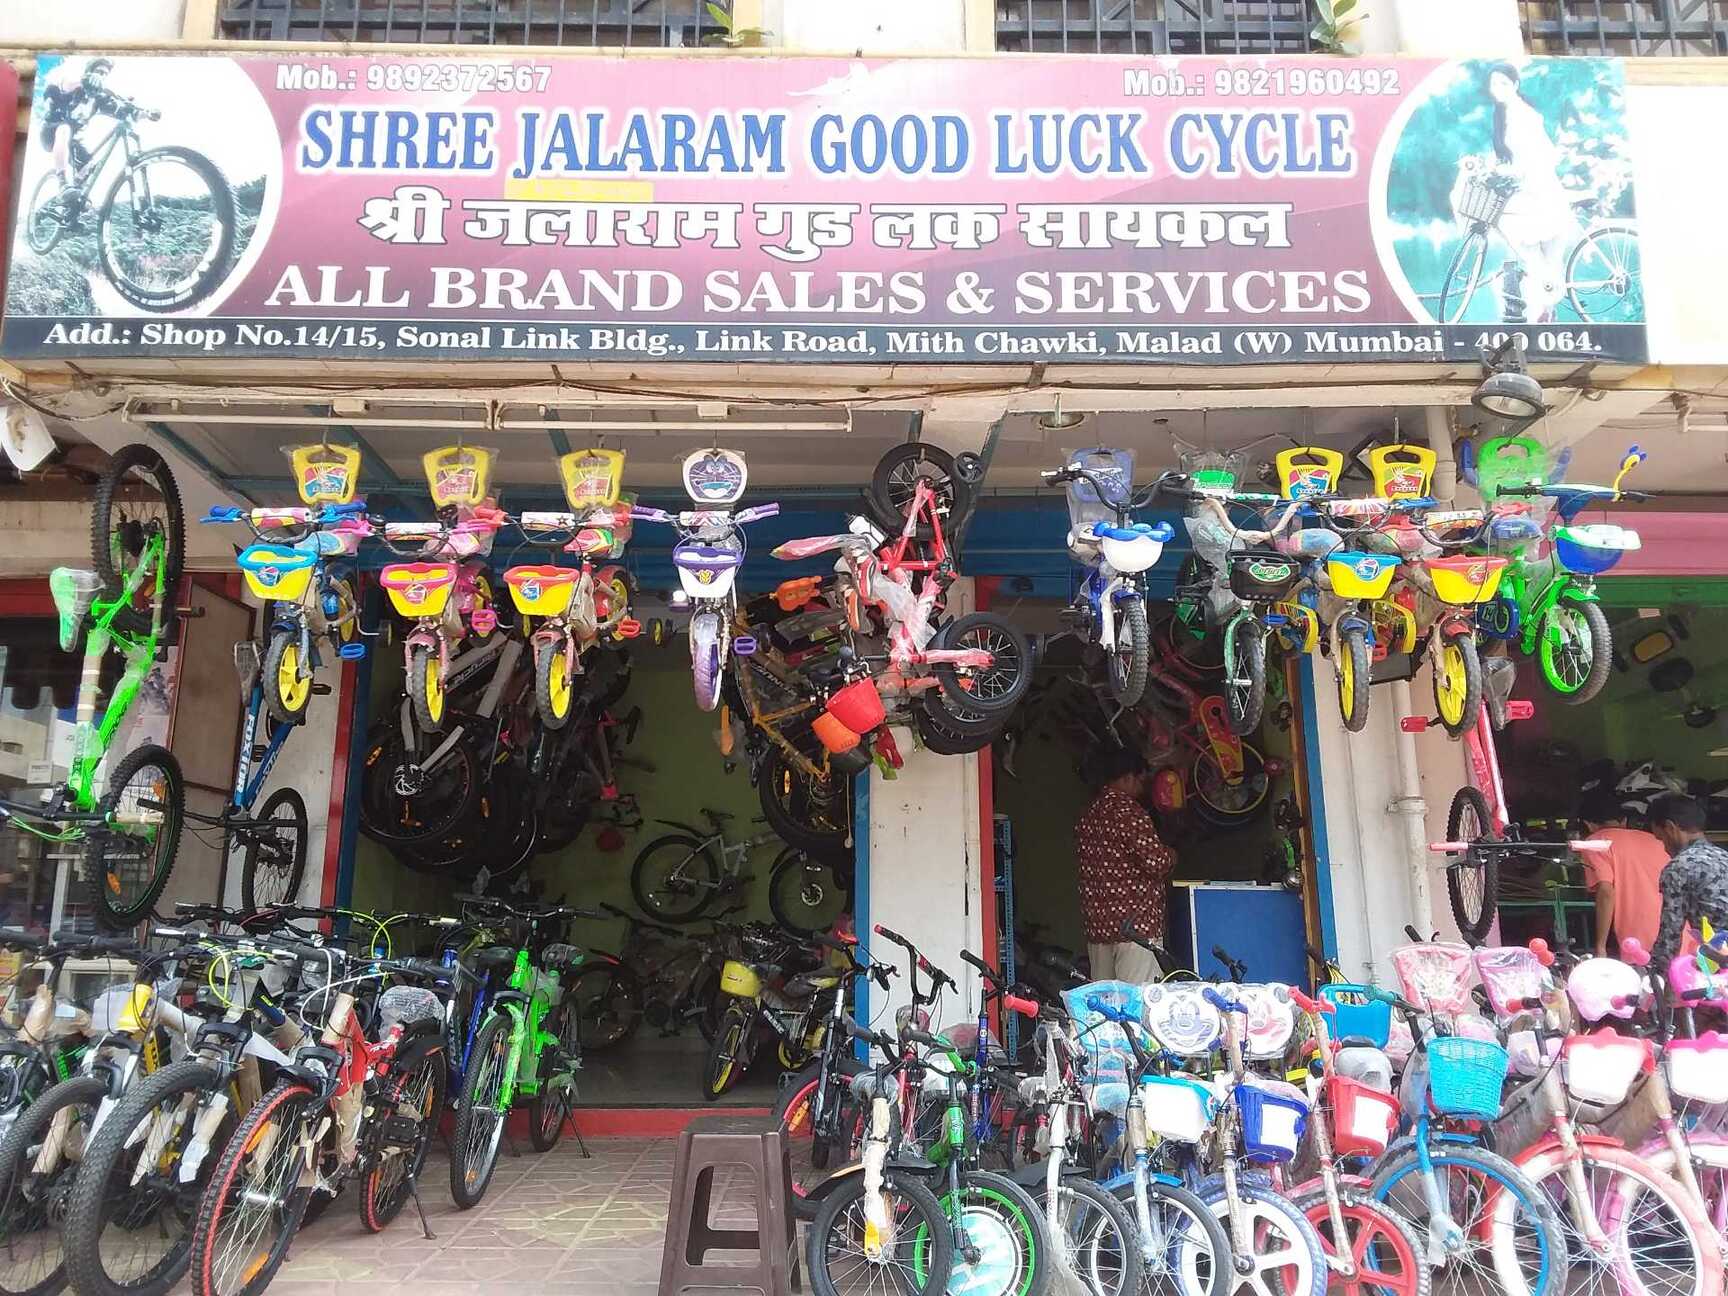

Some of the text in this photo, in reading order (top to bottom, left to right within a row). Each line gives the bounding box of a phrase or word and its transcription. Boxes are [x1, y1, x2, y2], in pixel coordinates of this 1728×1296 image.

[276, 64, 552, 92] Mob.: 9892372567
[1124, 68, 1400, 96] Mob.: 9821960492
[302, 111, 1352, 178] SHREE JALARAM GOOD LUCK CYCLE
[357, 185, 1294, 263] श्री जलाराम गुड लक सायकल
[265, 265, 1371, 314] ALL BRAND SALES & SERVICES
[43, 323, 131, 345] Add.:
[140, 324, 226, 351] Shop
[235, 324, 386, 350] No.14/15,
[396, 325, 491, 349] Sonal
[500, 325, 581, 351] Link
[589, 328, 686, 356] Bldg.,
[695, 328, 773, 352] Link
[782, 328, 877, 356] Road,
[886, 329, 965, 354] Mith
[974, 330, 1107, 357] Chawki,
[1115, 331, 1223, 355] Malad
[1232, 331, 1293, 355] (W)
[1303, 331, 1445, 354] Mumbai
[1537, 331, 1602, 352] 064.
